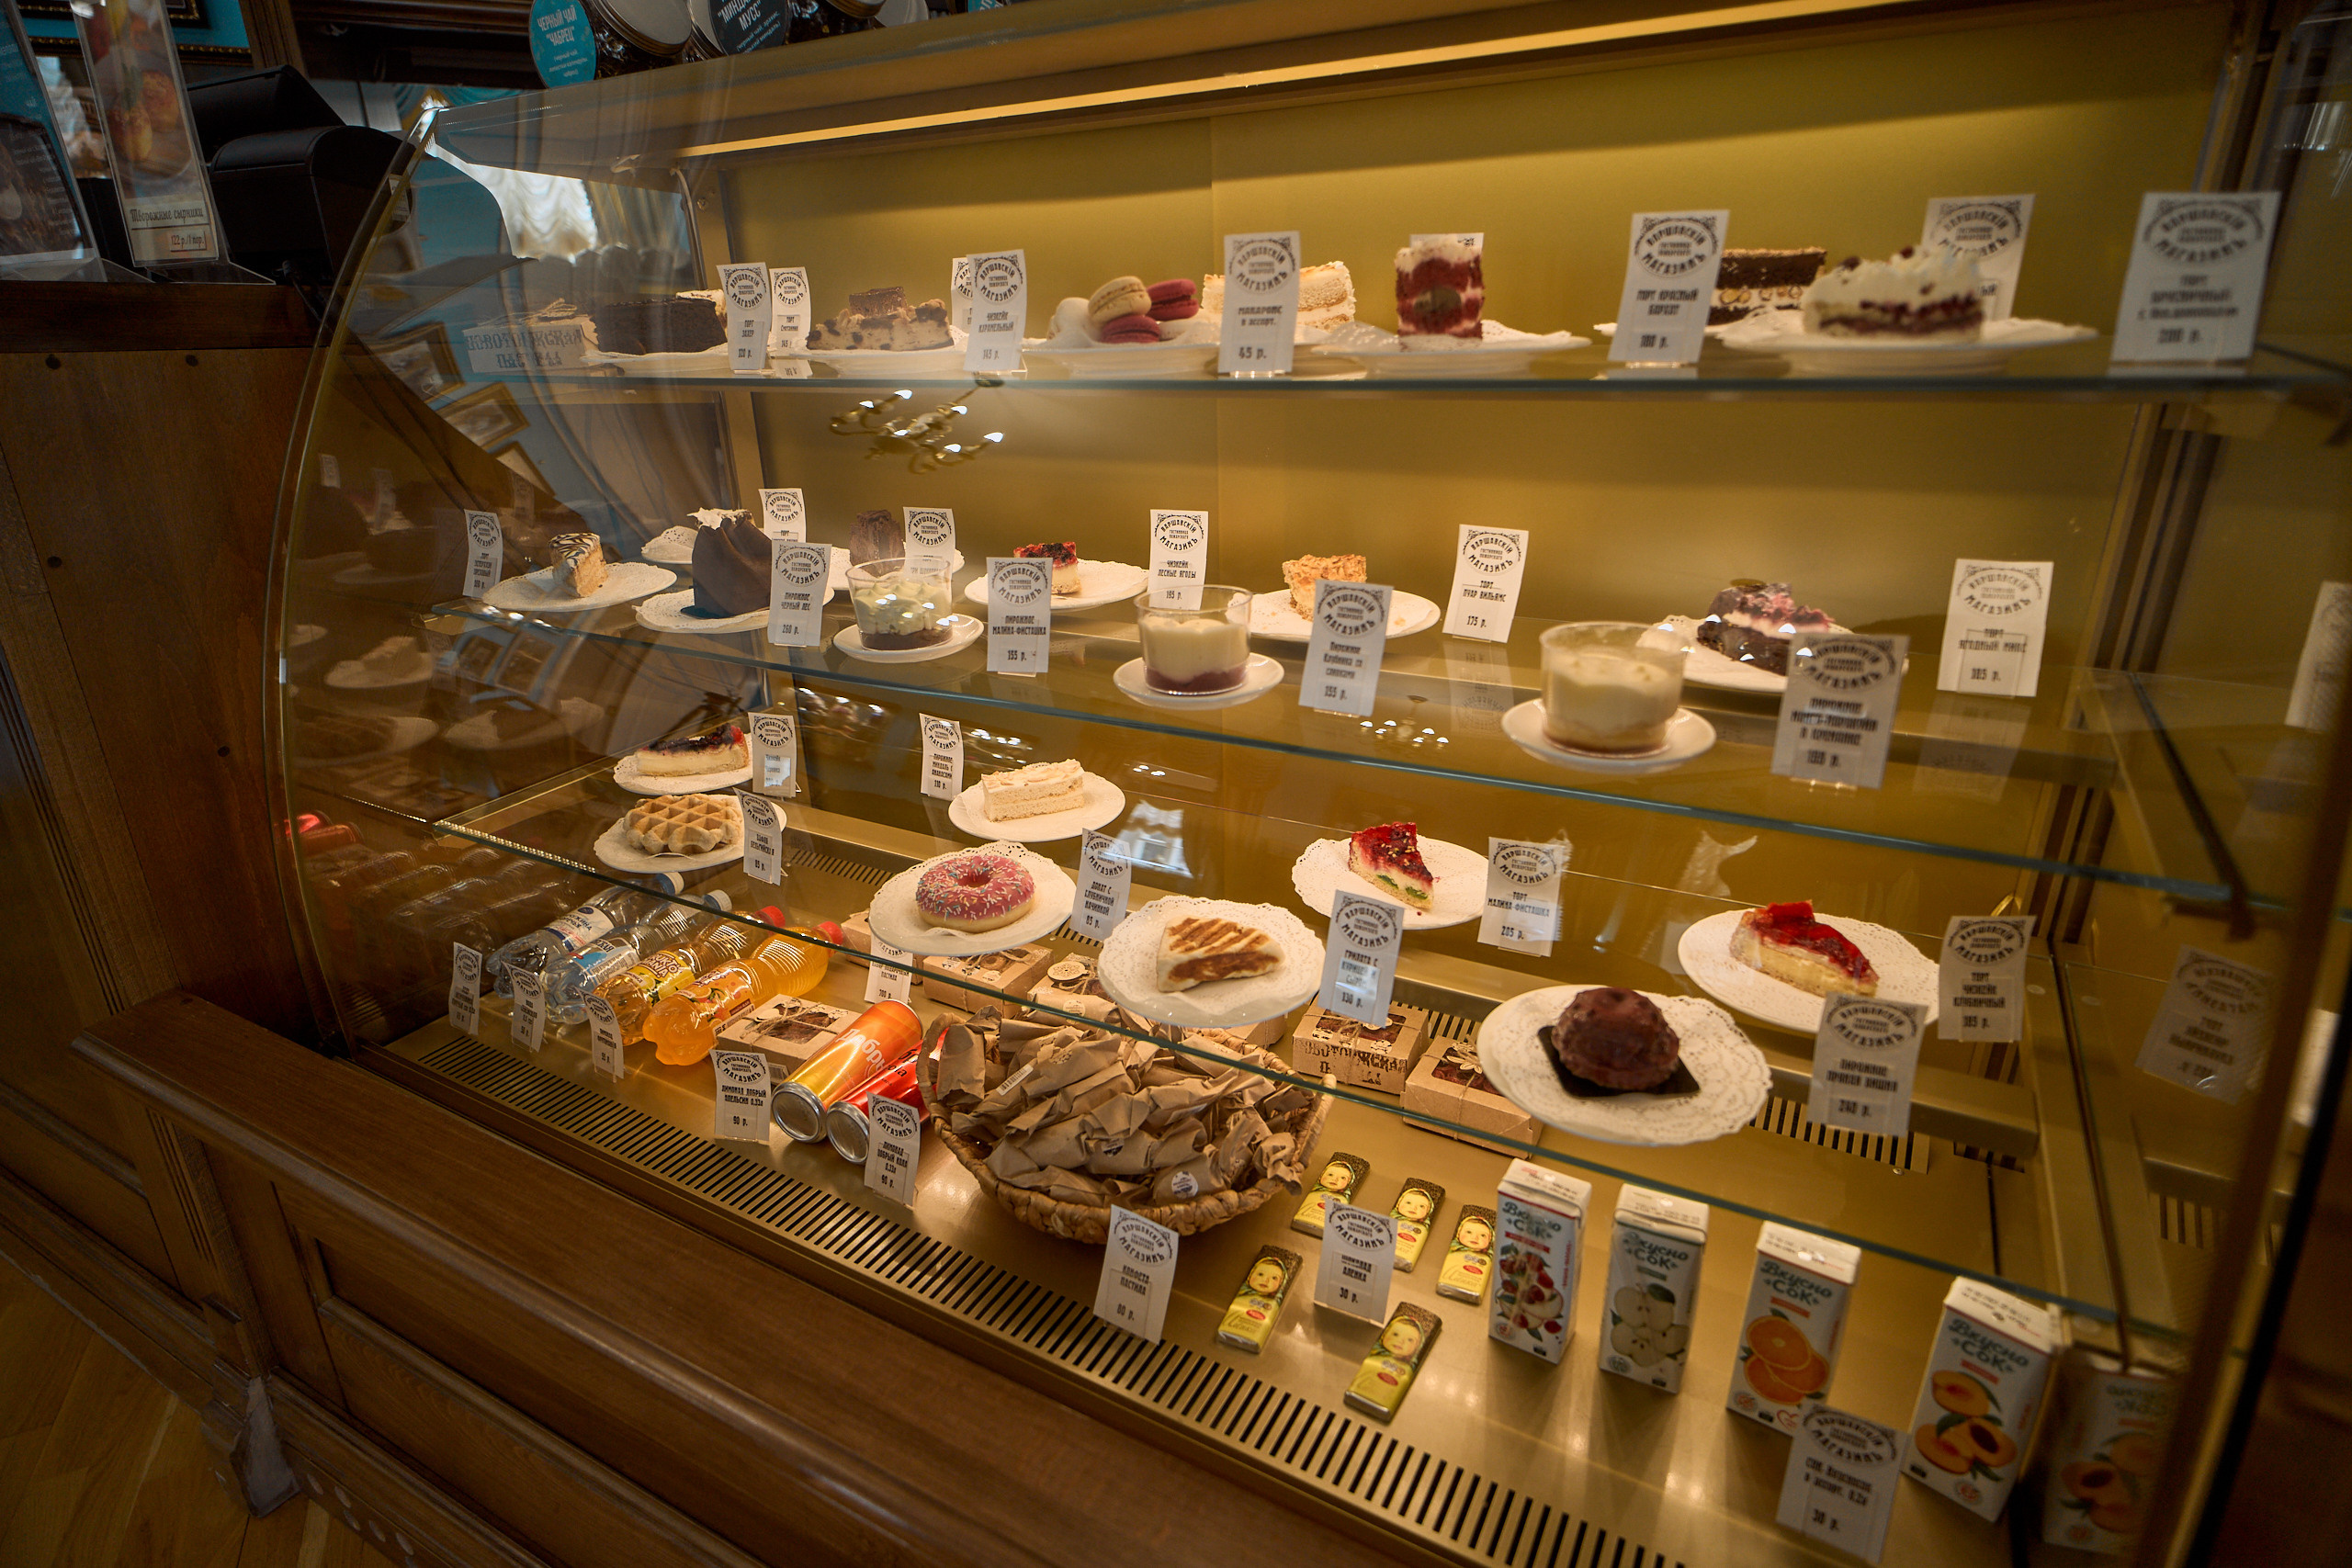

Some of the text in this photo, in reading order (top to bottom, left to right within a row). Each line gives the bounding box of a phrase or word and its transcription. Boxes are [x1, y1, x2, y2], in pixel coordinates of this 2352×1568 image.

[537, 5, 577, 31] ЧЕРНЫЙ ЧАЙ
[130, 209, 172, 226] Творожные
[988, 311, 1009, 321] ЧИЗКЕЙК
[978, 322, 1013, 333] КАРАМЕЛЬНЫЙ
[1239, 347, 1266, 358] 45 р.
[1159, 536, 1198, 550] МАГАЗИНЪ
[1468, 554, 1513, 572] МАГАЗИНЪ
[782, 569, 820, 583] МАГАЗИНЪ
[1480, 581, 1494, 589] ТОРТ
[785, 592, 810, 601] ПИРОЖНОЕ
[999, 587, 1041, 604] МАГАЗИНЪ
[1463, 589, 1506, 602] ПУАР ВИЛЬЯМС
[782, 602, 810, 611] ЧЕРНЫЙ ЛЕС
[1005, 615, 1035, 624] ПИРОЖНОЕ
[1324, 614, 1375, 635] МАГАЗИНЪ
[1467, 615, 1487, 627] 175 р.
[782, 625, 798, 635] 260 р.
[992, 626, 1046, 635] МАЛИНА-ФИСТАШКА
[1008, 650, 1026, 661] 155 р.
[1499, 863, 1548, 883] МАГАЗИНЪ
[1512, 892, 1528, 901] ТОРТ
[1341, 925, 1388, 947] МАГАЗИНЪ
[723, 1068, 761, 1082] МАГАЗИНЪ
[722, 1085, 766, 1098] ЛИМОНАД ДОБРЫЙ
[725, 1095, 749, 1105] АПЕЛЬСИН
[733, 1116, 748, 1126] 90 р.
[877, 1117, 912, 1136] МАГАЗИНЪ
[883, 1141, 904, 1156] ЛИМОНАД
[877, 1149, 908, 1168] ДОБРЫЙ КОЛА
[882, 1174, 894, 1188] 90 р.
[1336, 1225, 1385, 1247] МАГАЗИНЪ
[1120, 1236, 1165, 1263] МАГАЗИНЪ
[1120, 1277, 1147, 1295] ПАСТИЛА
[1339, 1286, 1358, 1303] 30 р.
[1128, 1310, 1135, 1321] р.
